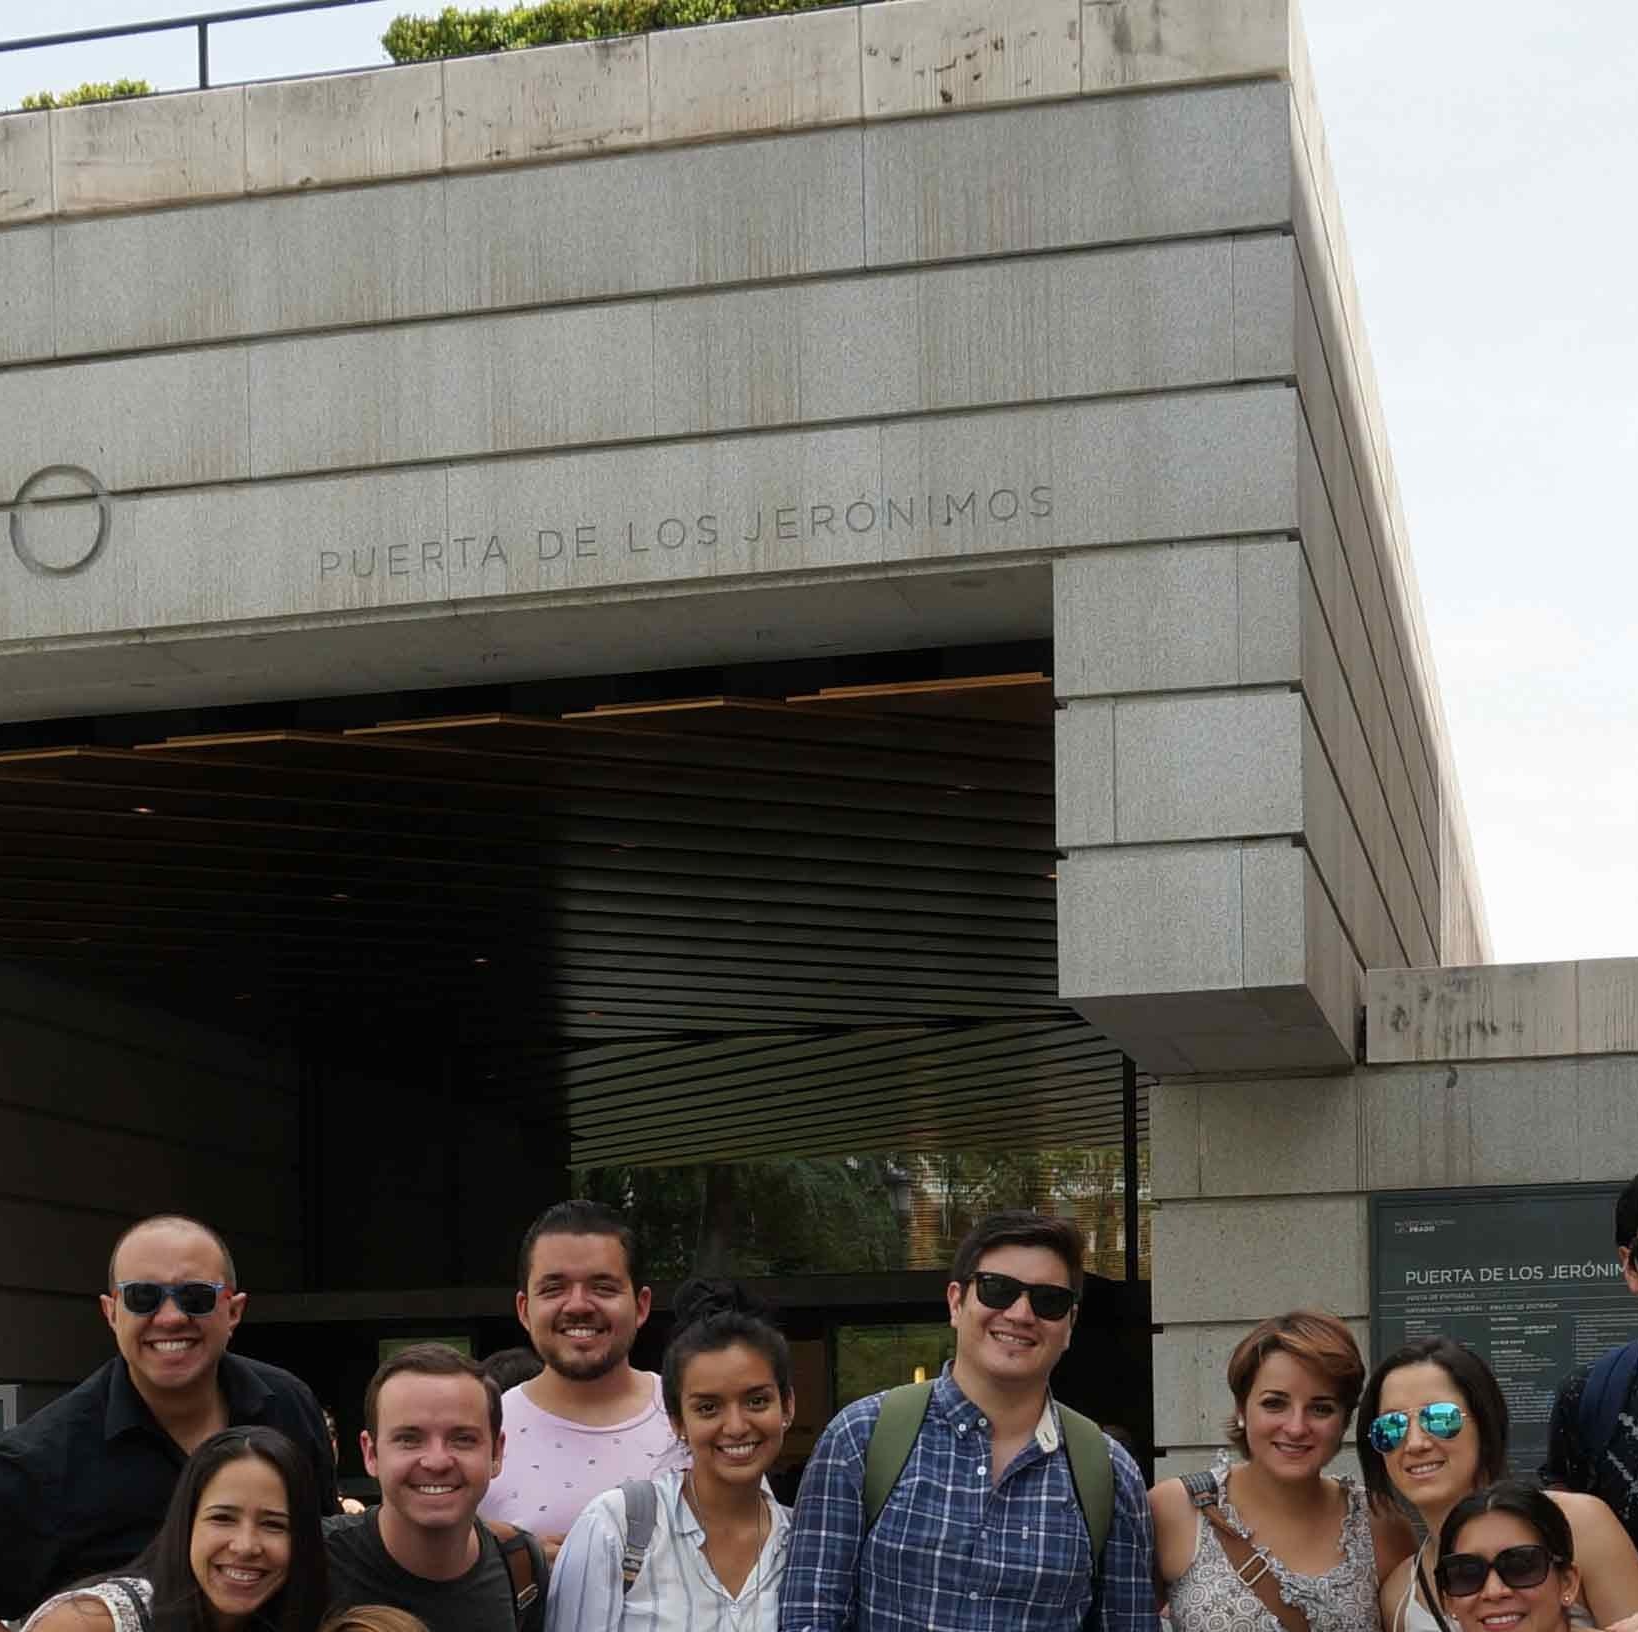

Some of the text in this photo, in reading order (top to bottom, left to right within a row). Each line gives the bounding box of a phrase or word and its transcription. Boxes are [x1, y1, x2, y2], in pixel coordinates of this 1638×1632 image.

[319, 486, 1054, 582] PUERTA DE LOS JERÓNIMOS
[1405, 1259, 1627, 1286] PUERTA DE LOS JERÓNIM
